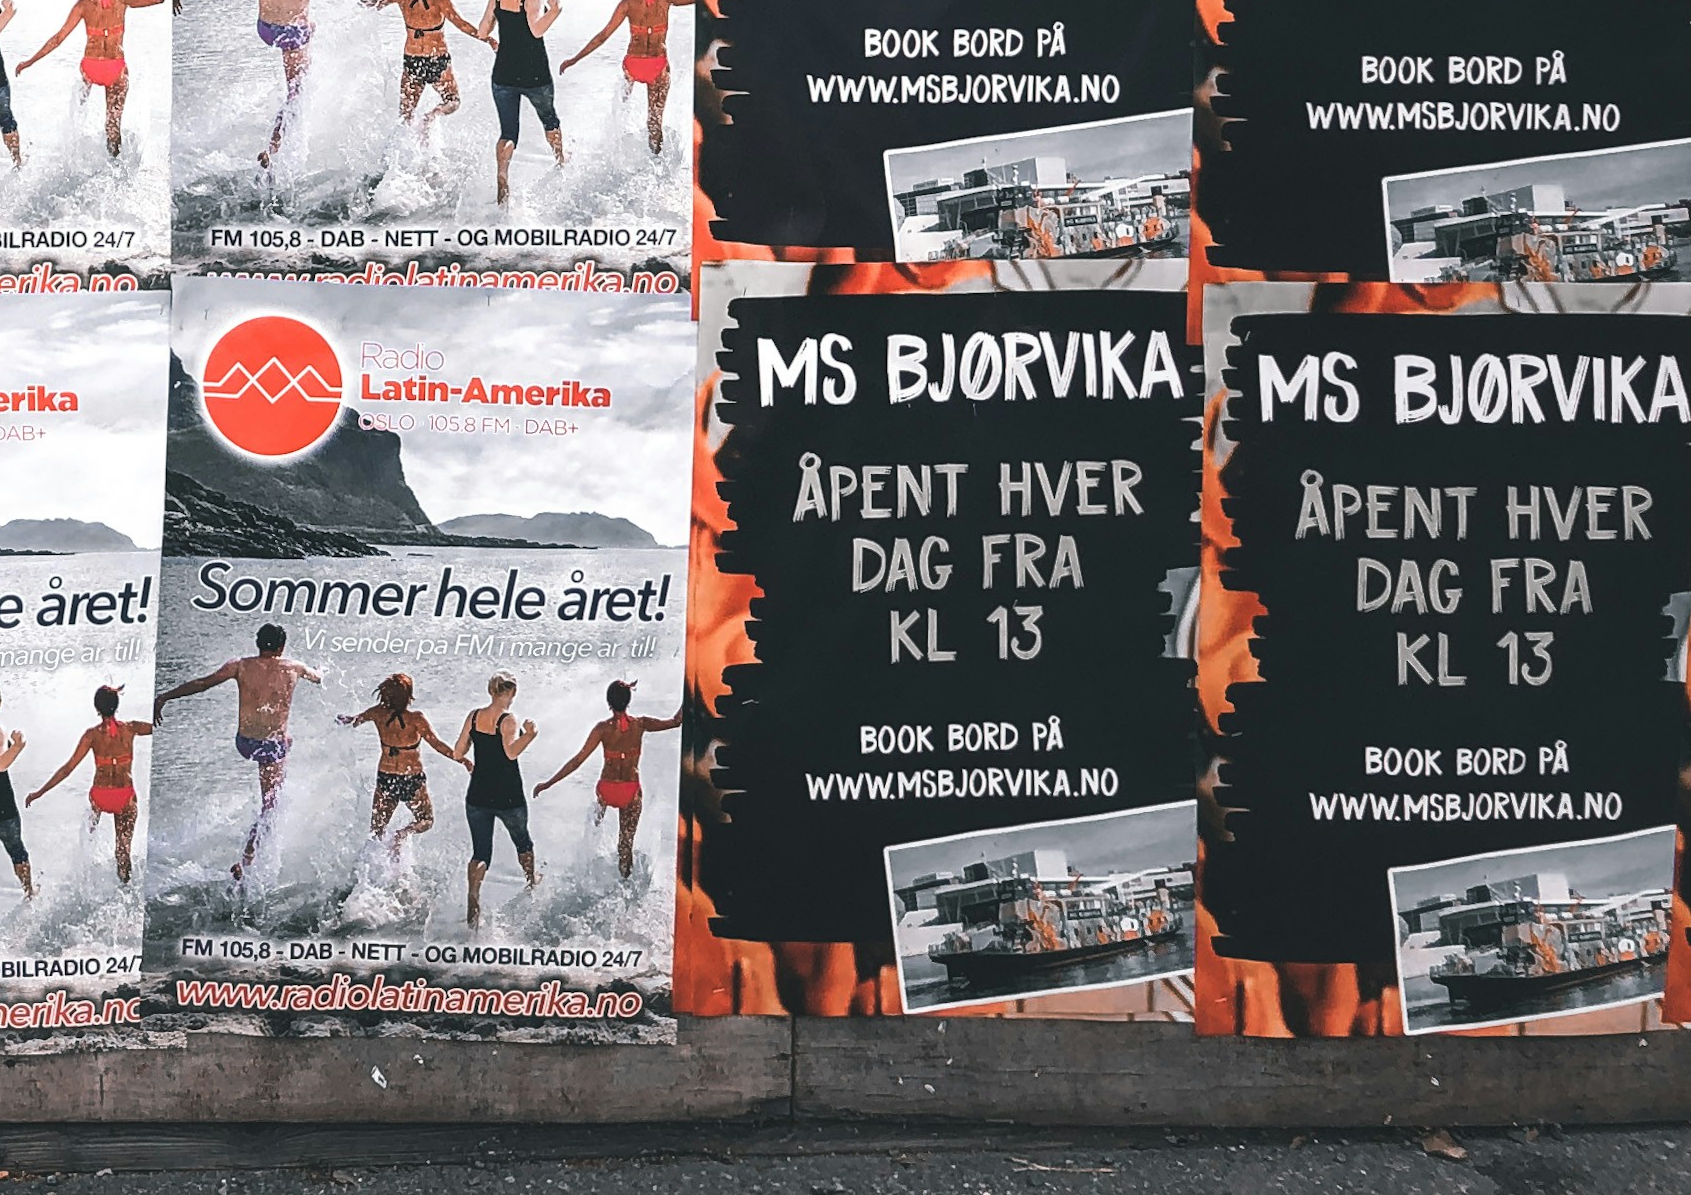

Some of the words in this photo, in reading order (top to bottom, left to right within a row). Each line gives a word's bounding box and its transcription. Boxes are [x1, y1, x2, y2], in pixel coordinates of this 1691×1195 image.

[360, 341, 445, 371] Radio
[360, 373, 612, 409] Latin-Amerika
[1258, 352, 1360, 424] MS
[1394, 353, 1691, 425] BJØRVIKA
[1295, 470, 1477, 541] ÅPENT
[1506, 485, 1653, 541] HVER
[192, 560, 427, 618] Sommer
[434, 566, 544, 622] hele
[557, 570, 673, 623] året!
[1357, 558, 1463, 614] DAG
[1490, 558, 1593, 615] FRA
[1397, 632, 1467, 686] KL
[1496, 631, 1555, 686] 13
[1365, 747, 1442, 776] BOOK
[1456, 748, 1526, 776] BORD
[1539, 740, 1570, 775] PÅ
[1309, 792, 1623, 822] WWW.MSBJORVIKA.NO
[181, 939, 212, 957] FM
[219, 940, 270, 960] 105,8
[290, 942, 332, 961] DAB
[352, 944, 406, 963] NETT
[425, 946, 456, 964] OG
[462, 947, 596, 967] MOBILRADIO
[602, 949, 643, 968] 24/7
[175, 973, 642, 1018] www.radiolatinamerika.no
